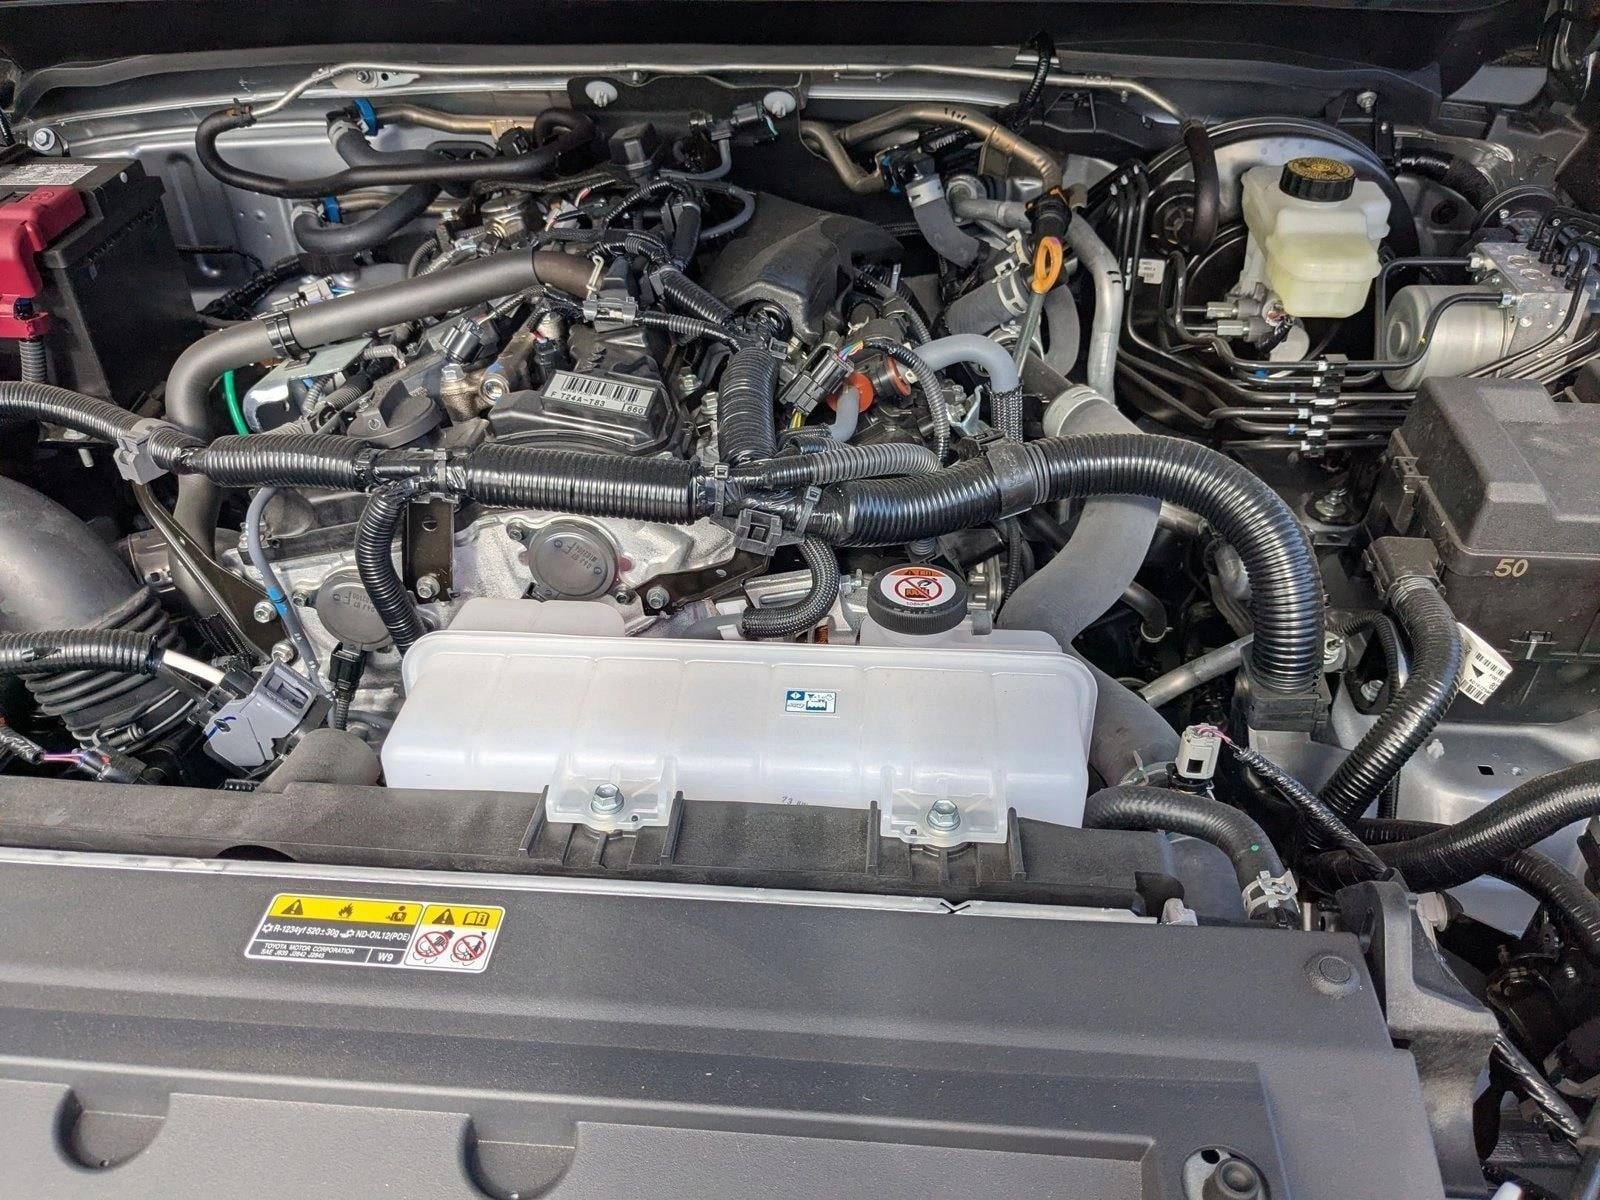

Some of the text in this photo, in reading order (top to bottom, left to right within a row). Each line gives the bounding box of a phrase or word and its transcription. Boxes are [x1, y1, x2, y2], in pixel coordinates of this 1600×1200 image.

[1493, 558, 1529, 578] 50
[355, 929, 411, 942] ND-OIL12(POE)
[312, 946, 356, 954] CORPORATION
[377, 952, 394, 962] W9
